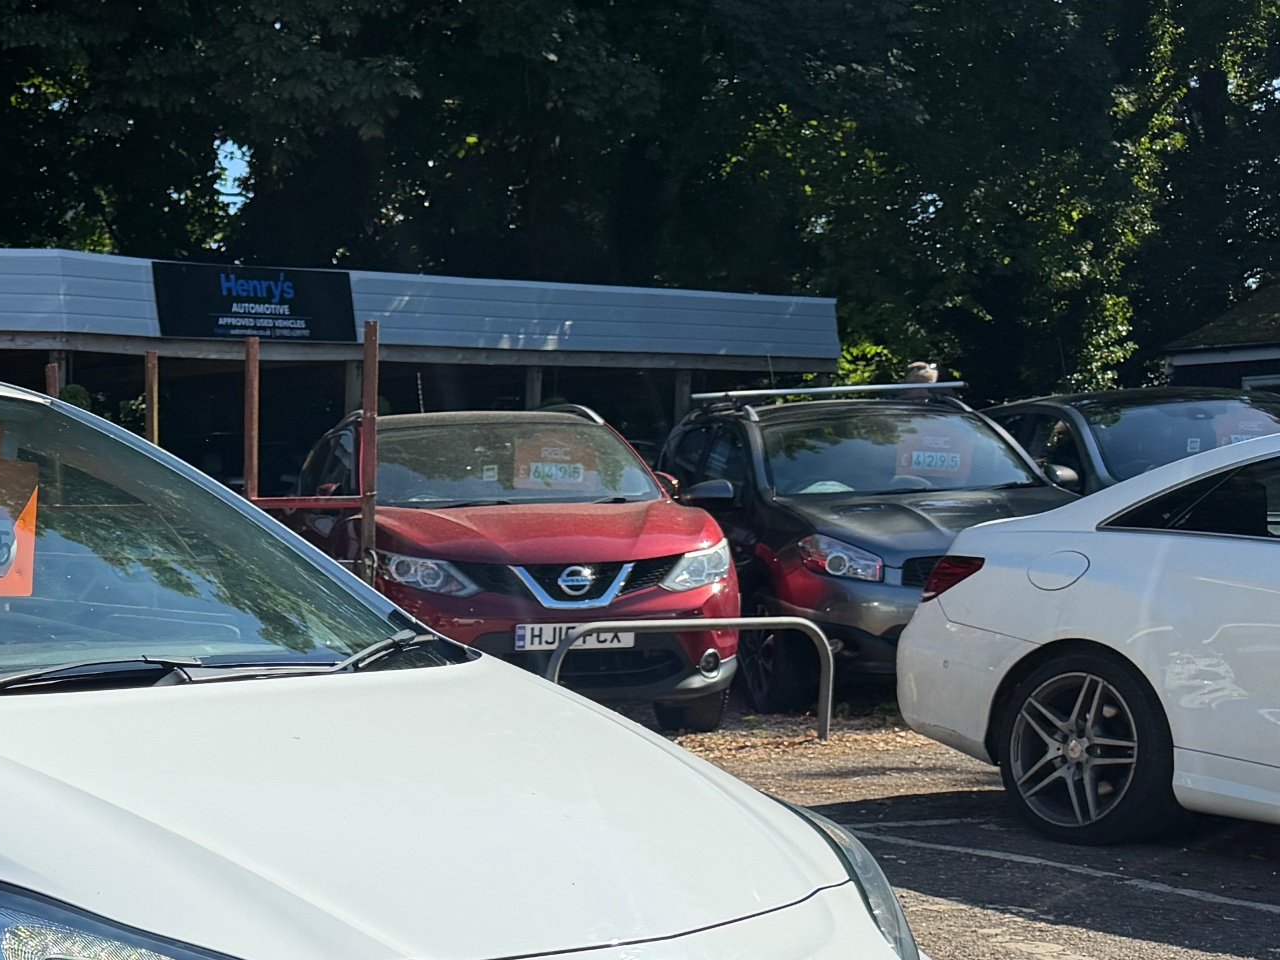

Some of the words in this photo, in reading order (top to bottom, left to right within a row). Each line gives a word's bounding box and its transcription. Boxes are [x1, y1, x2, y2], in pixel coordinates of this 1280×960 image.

[220, 272, 295, 304] Henry's
[231, 302, 291, 315] AUTOMOTIVE
[218, 316, 255, 326] APPROVED
[913, 454, 958, 469] 4295
